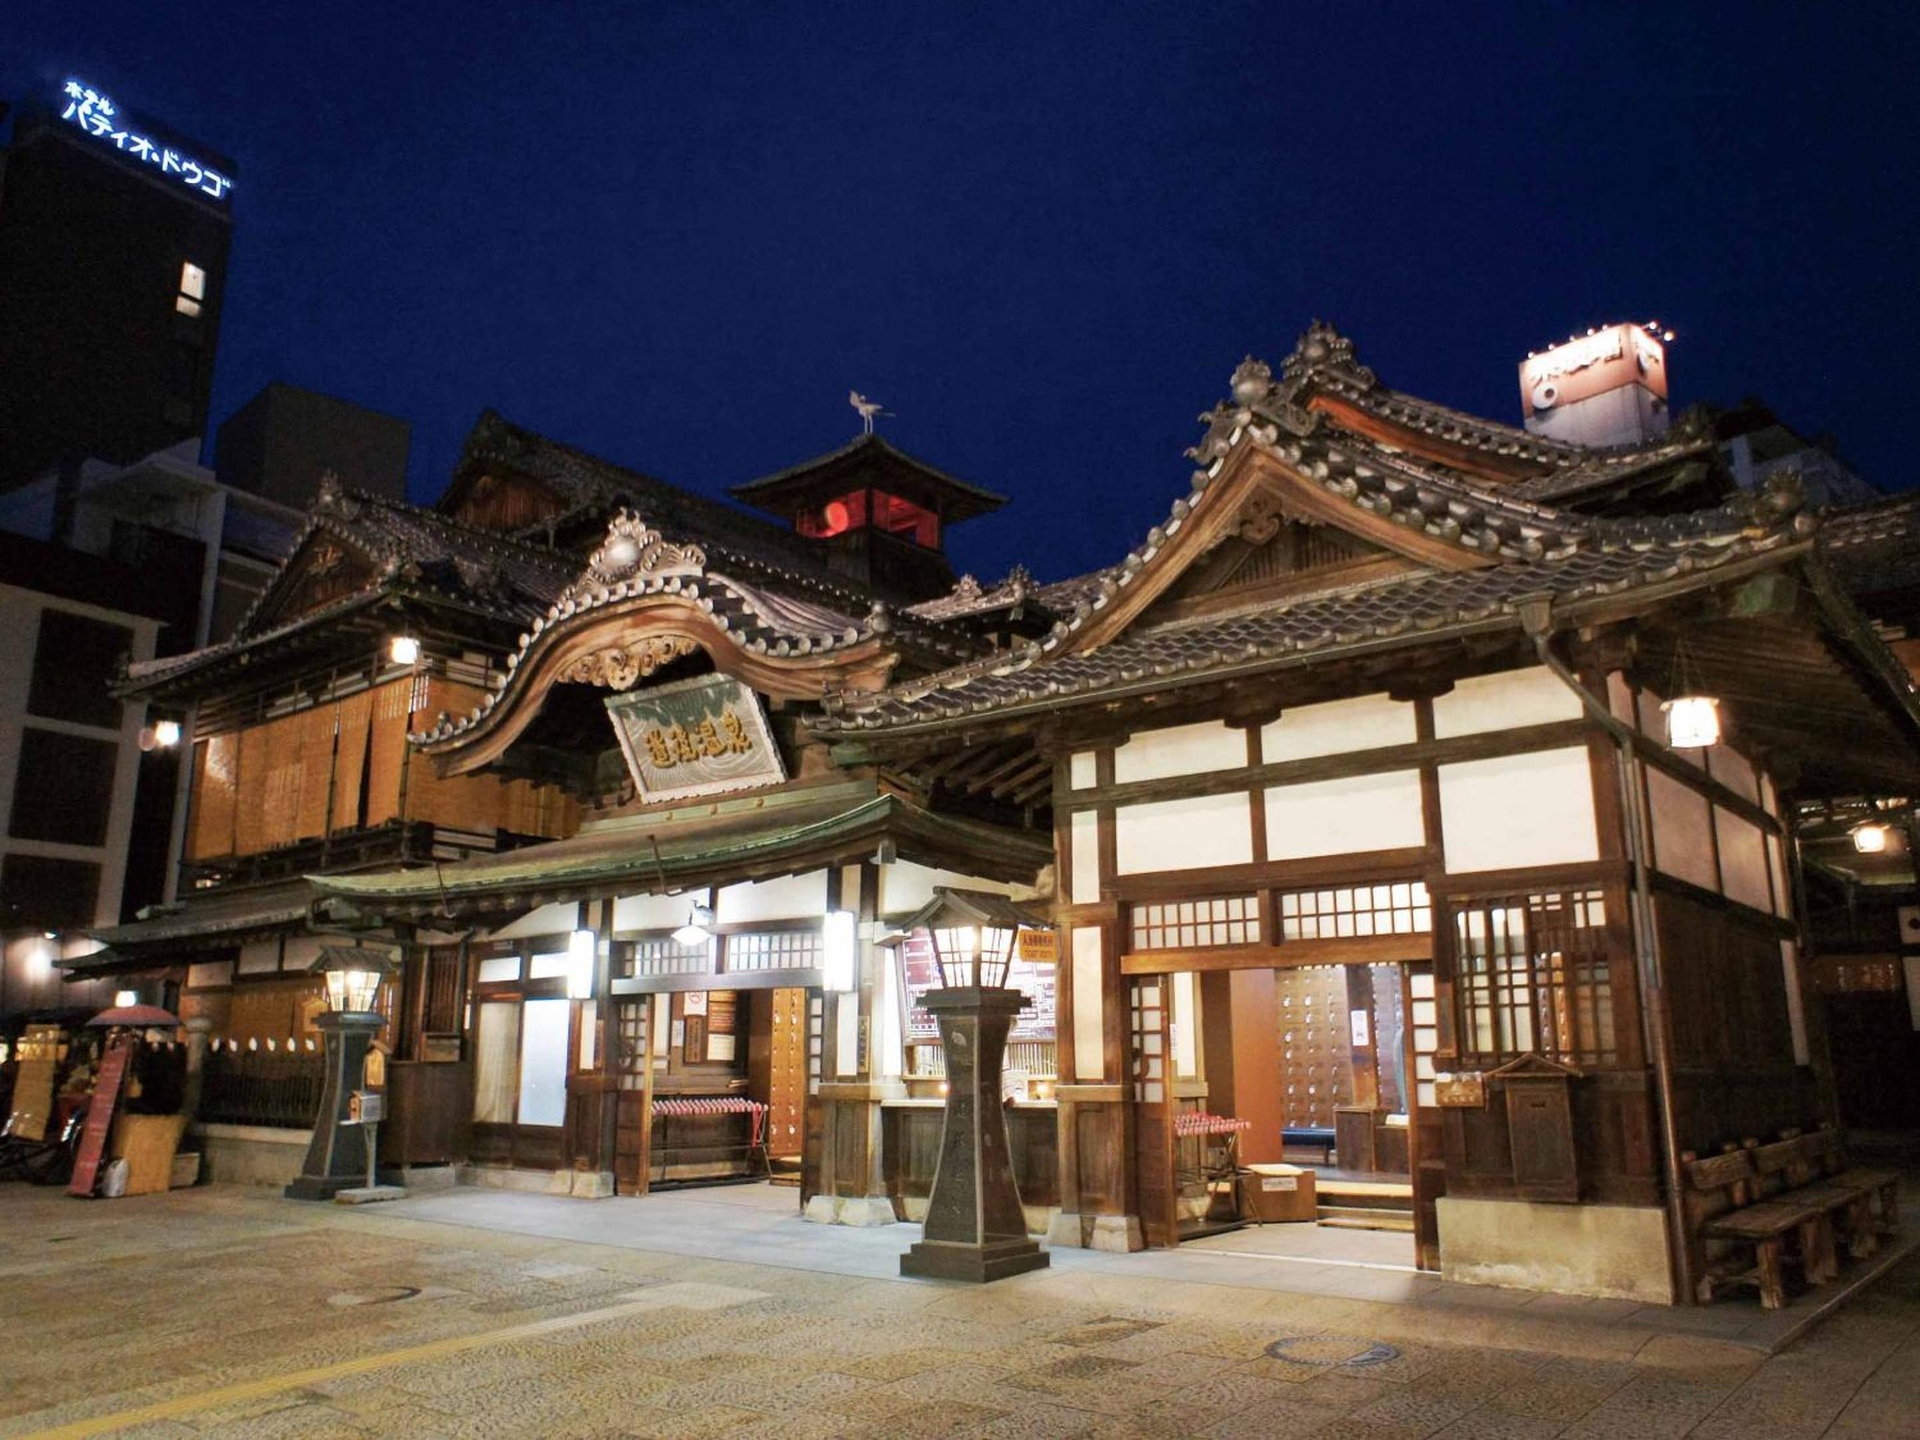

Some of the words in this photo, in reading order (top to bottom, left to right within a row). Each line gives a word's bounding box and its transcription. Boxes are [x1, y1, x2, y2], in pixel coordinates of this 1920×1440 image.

[63, 81, 115, 116] ホテル
[61, 101, 231, 197] パティオ・ドウゴ
